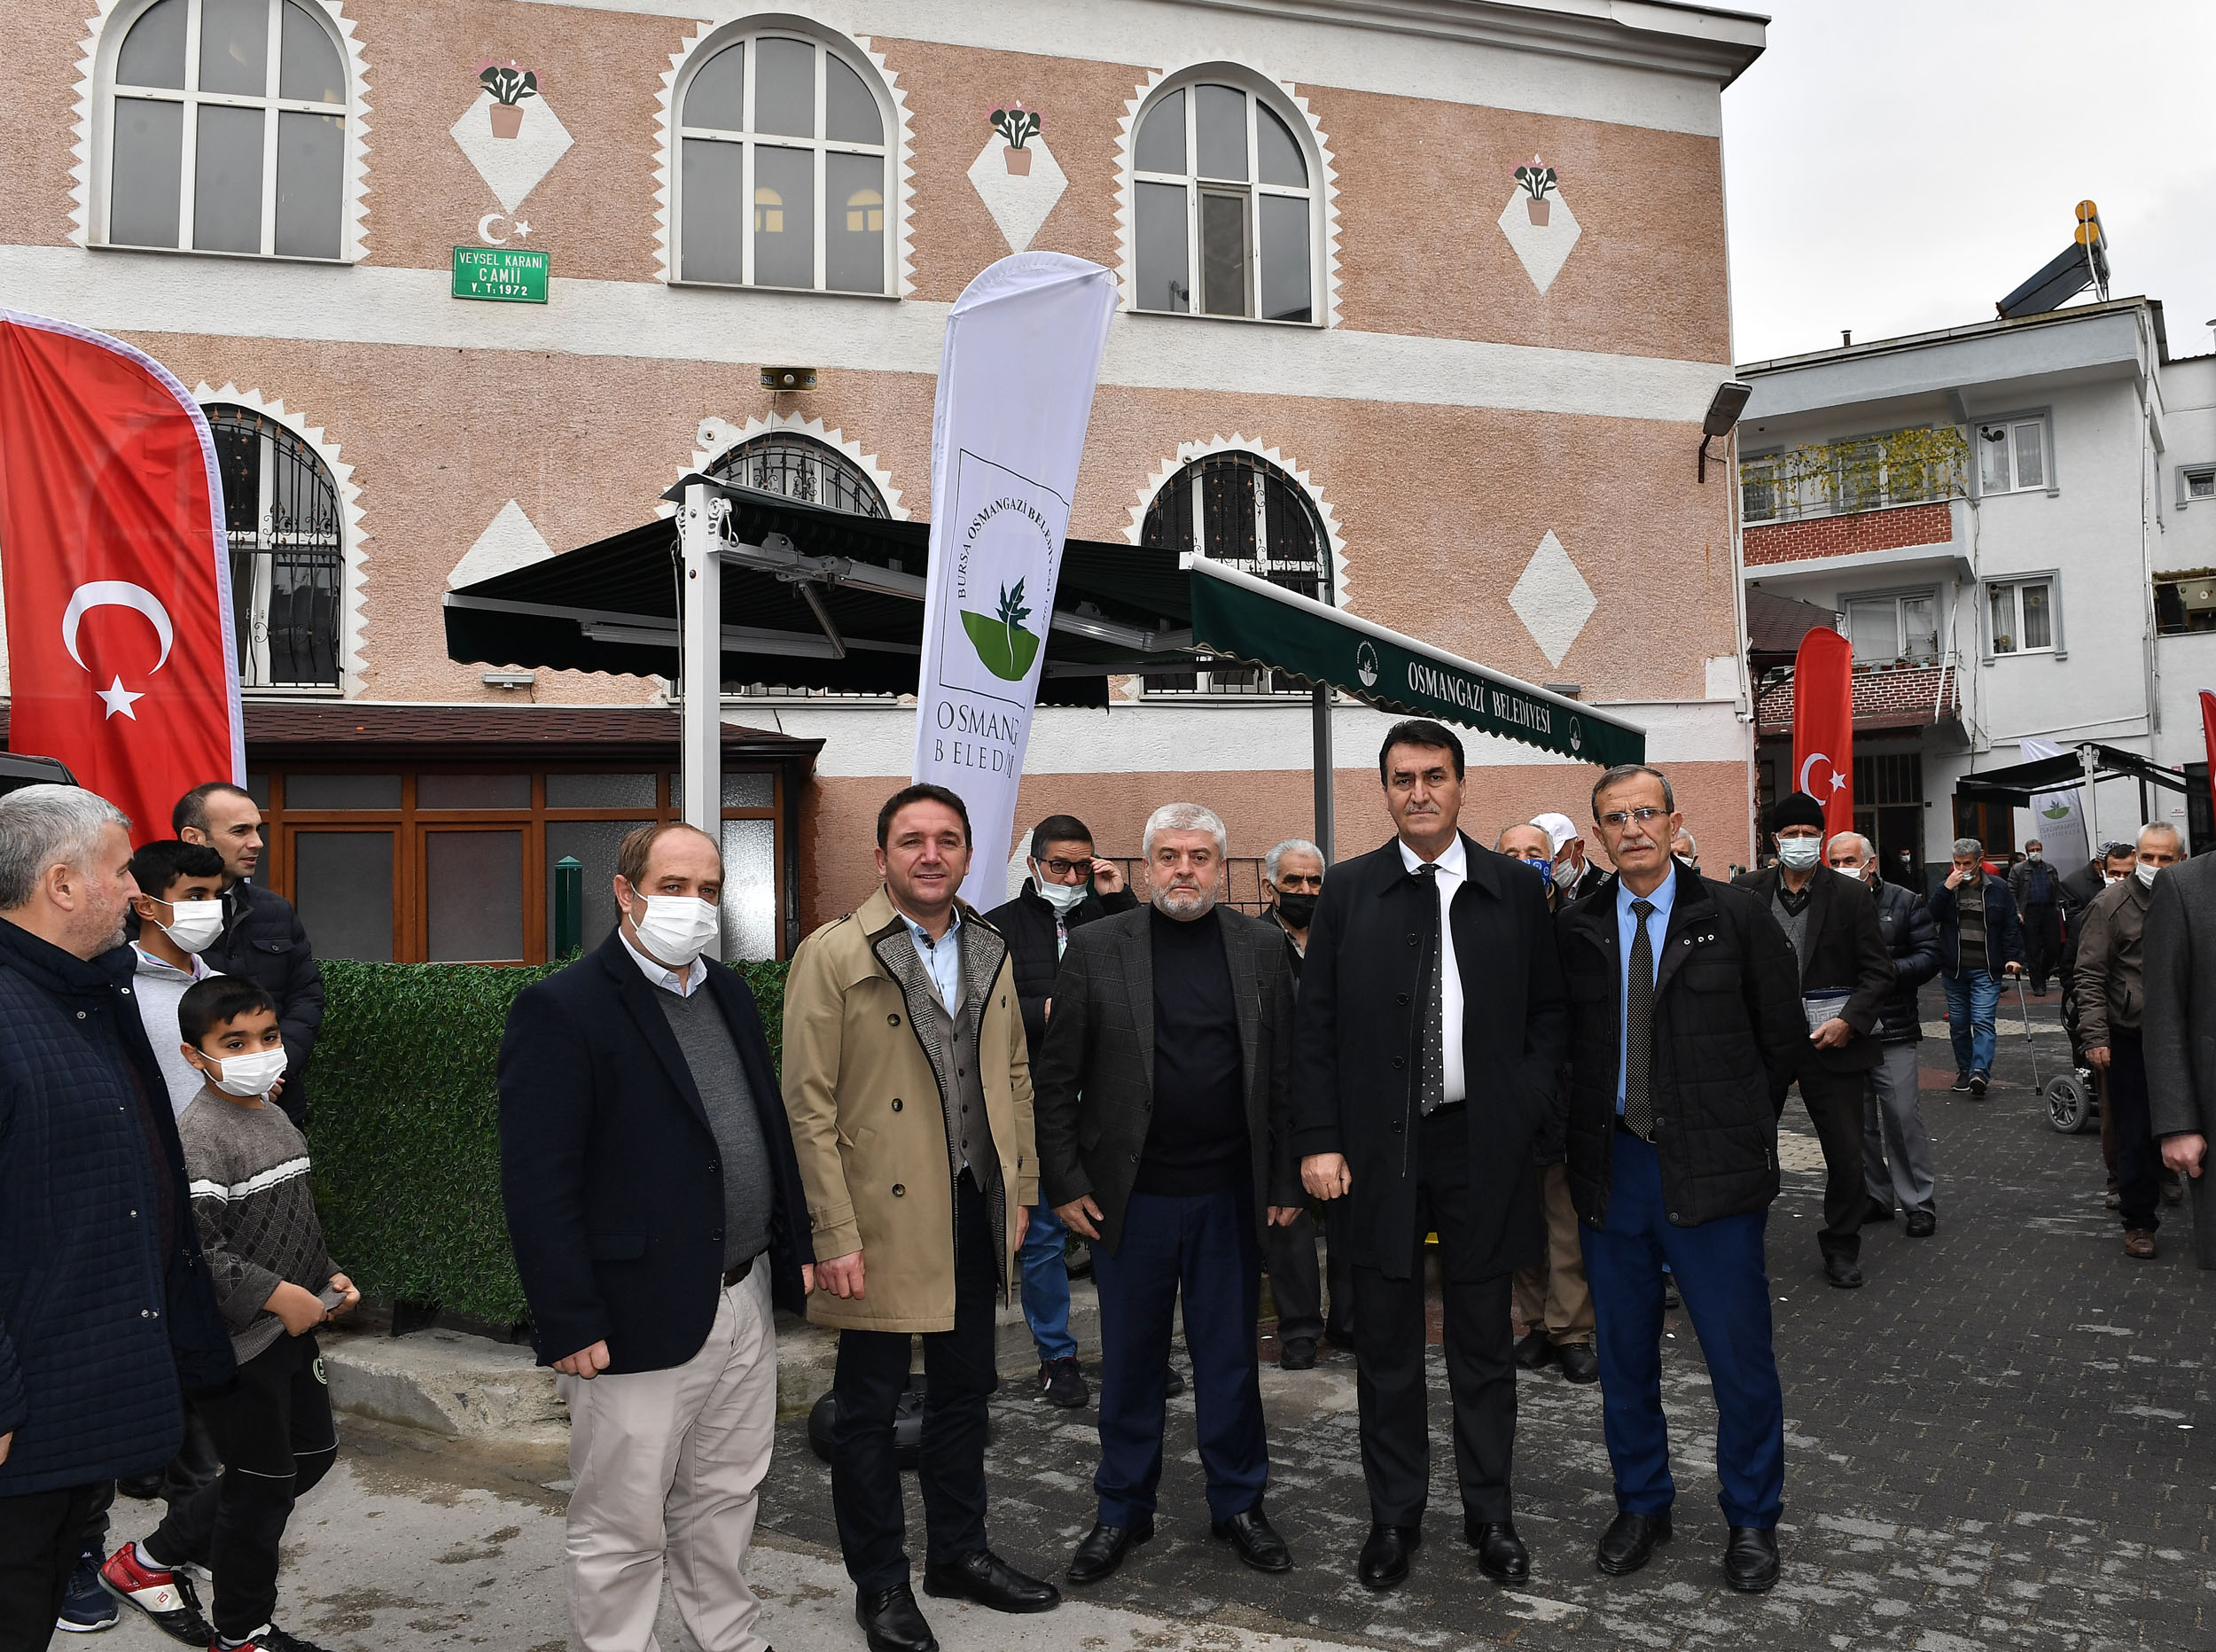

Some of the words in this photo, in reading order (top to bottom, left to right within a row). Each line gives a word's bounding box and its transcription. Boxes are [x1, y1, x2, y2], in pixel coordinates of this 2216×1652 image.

[459, 252, 500, 266] VEYSEL
[504, 254, 542, 269] KARANİ
[479, 267, 521, 284] CAMİİ
[957, 543, 971, 599] BURSA
[967, 496, 1027, 540] OSMANGAZİ
[1408, 661, 1486, 713] OSMANGAZİ
[1492, 690, 1552, 735] BELEDİYESİ
[157, 1591, 169, 1603] 10
